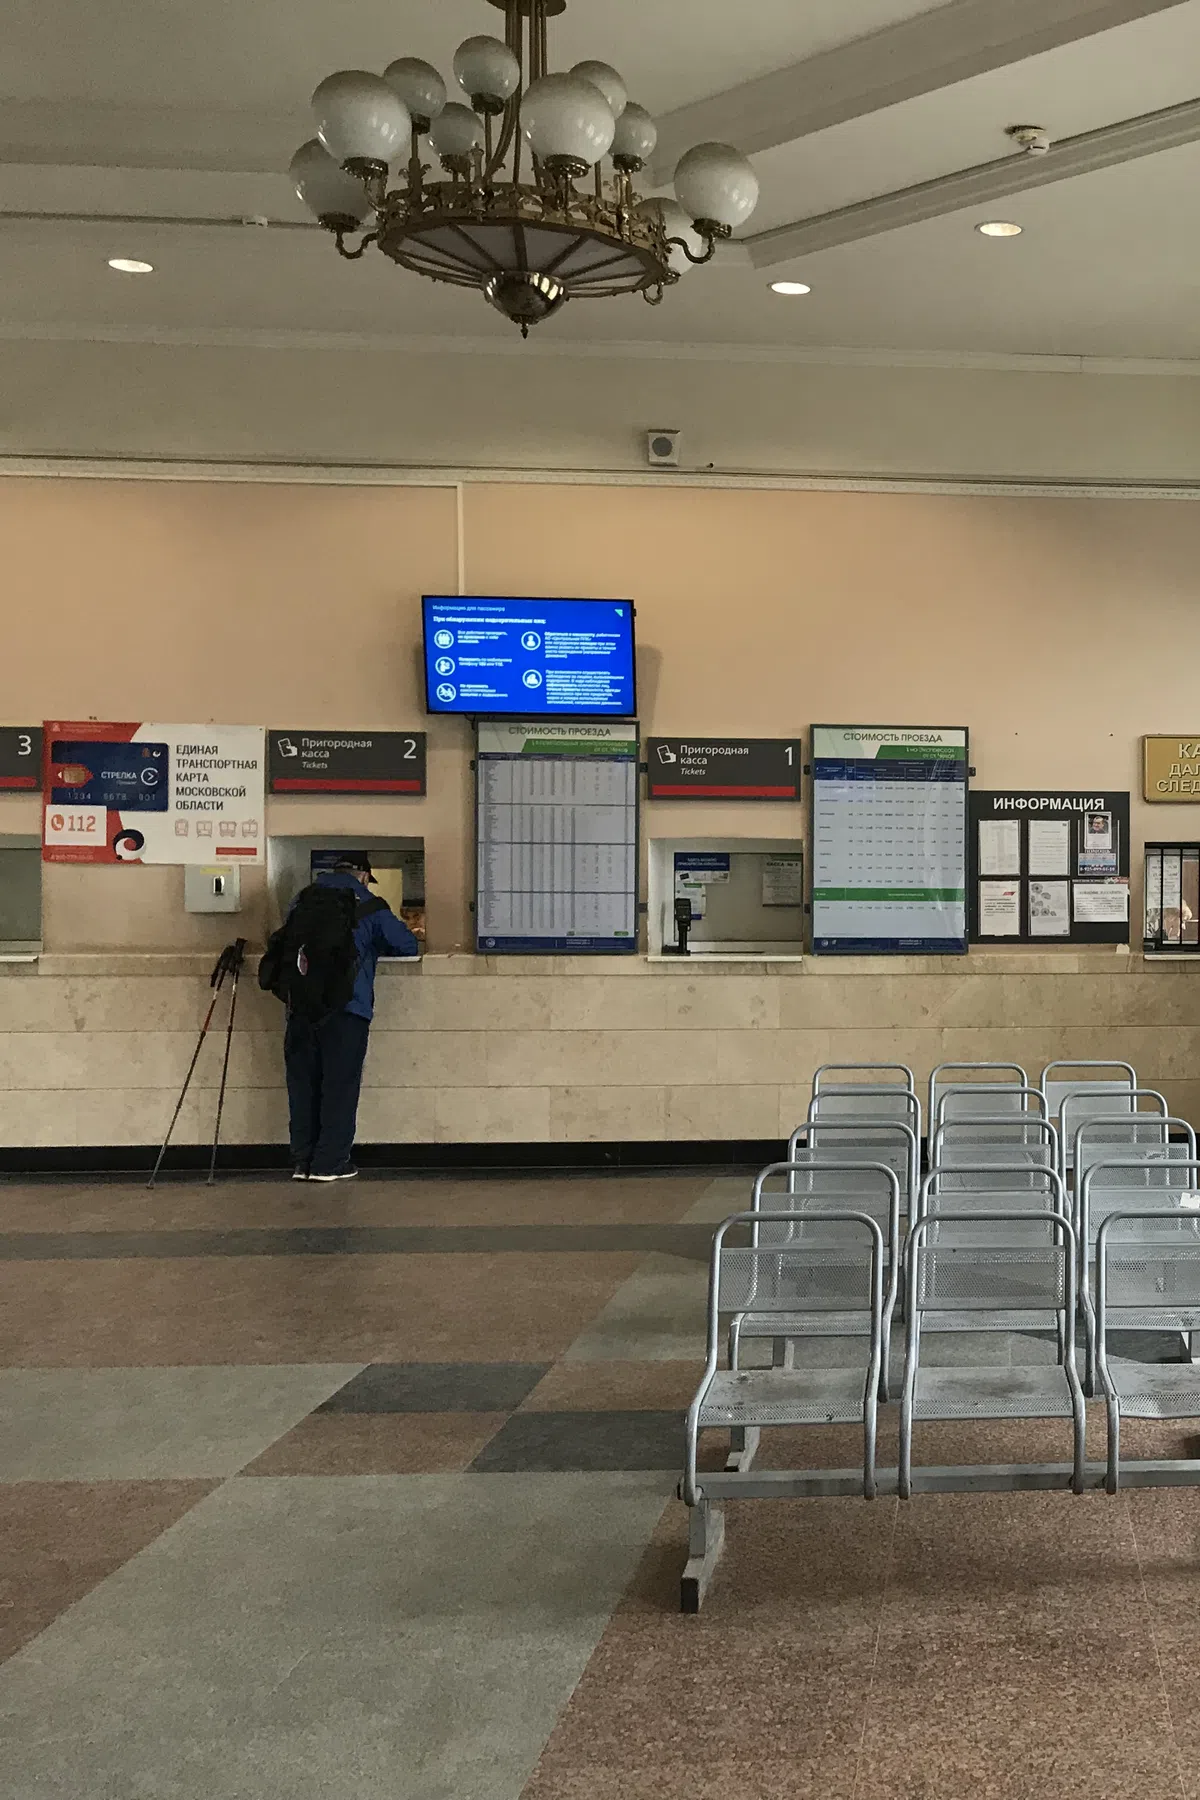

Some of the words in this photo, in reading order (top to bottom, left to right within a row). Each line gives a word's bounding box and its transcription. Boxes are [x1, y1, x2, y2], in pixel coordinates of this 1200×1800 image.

[508, 726, 566, 735] СТОИМОСТЬ
[568, 727, 611, 736] ПРОЕЗДА
[843, 732, 899, 742] СТОИМОСТЬ
[901, 733, 943, 743] ПРОЕЗДА
[18, 735, 32, 756] 3
[176, 745, 218, 756] ЕДИНАЯ
[301, 738, 373, 749] Пригородная
[403, 739, 417, 759] 2
[680, 745, 749, 756] Пригородная
[784, 746, 793, 766] 1
[680, 757, 708, 765] касса
[176, 758, 257, 770] ТРАНСПОРТНАЯ
[302, 761, 328, 769] Tickets
[101, 771, 137, 779] СТРЕЛКА
[176, 773, 209, 783] КАРТА
[176, 785, 246, 797] МОСКОВСКОЙ
[176, 801, 224, 811] ОБЛАСТИ
[993, 797, 1105, 812] ИНФОРМАЦИЯ
[68, 816, 96, 832] 112
